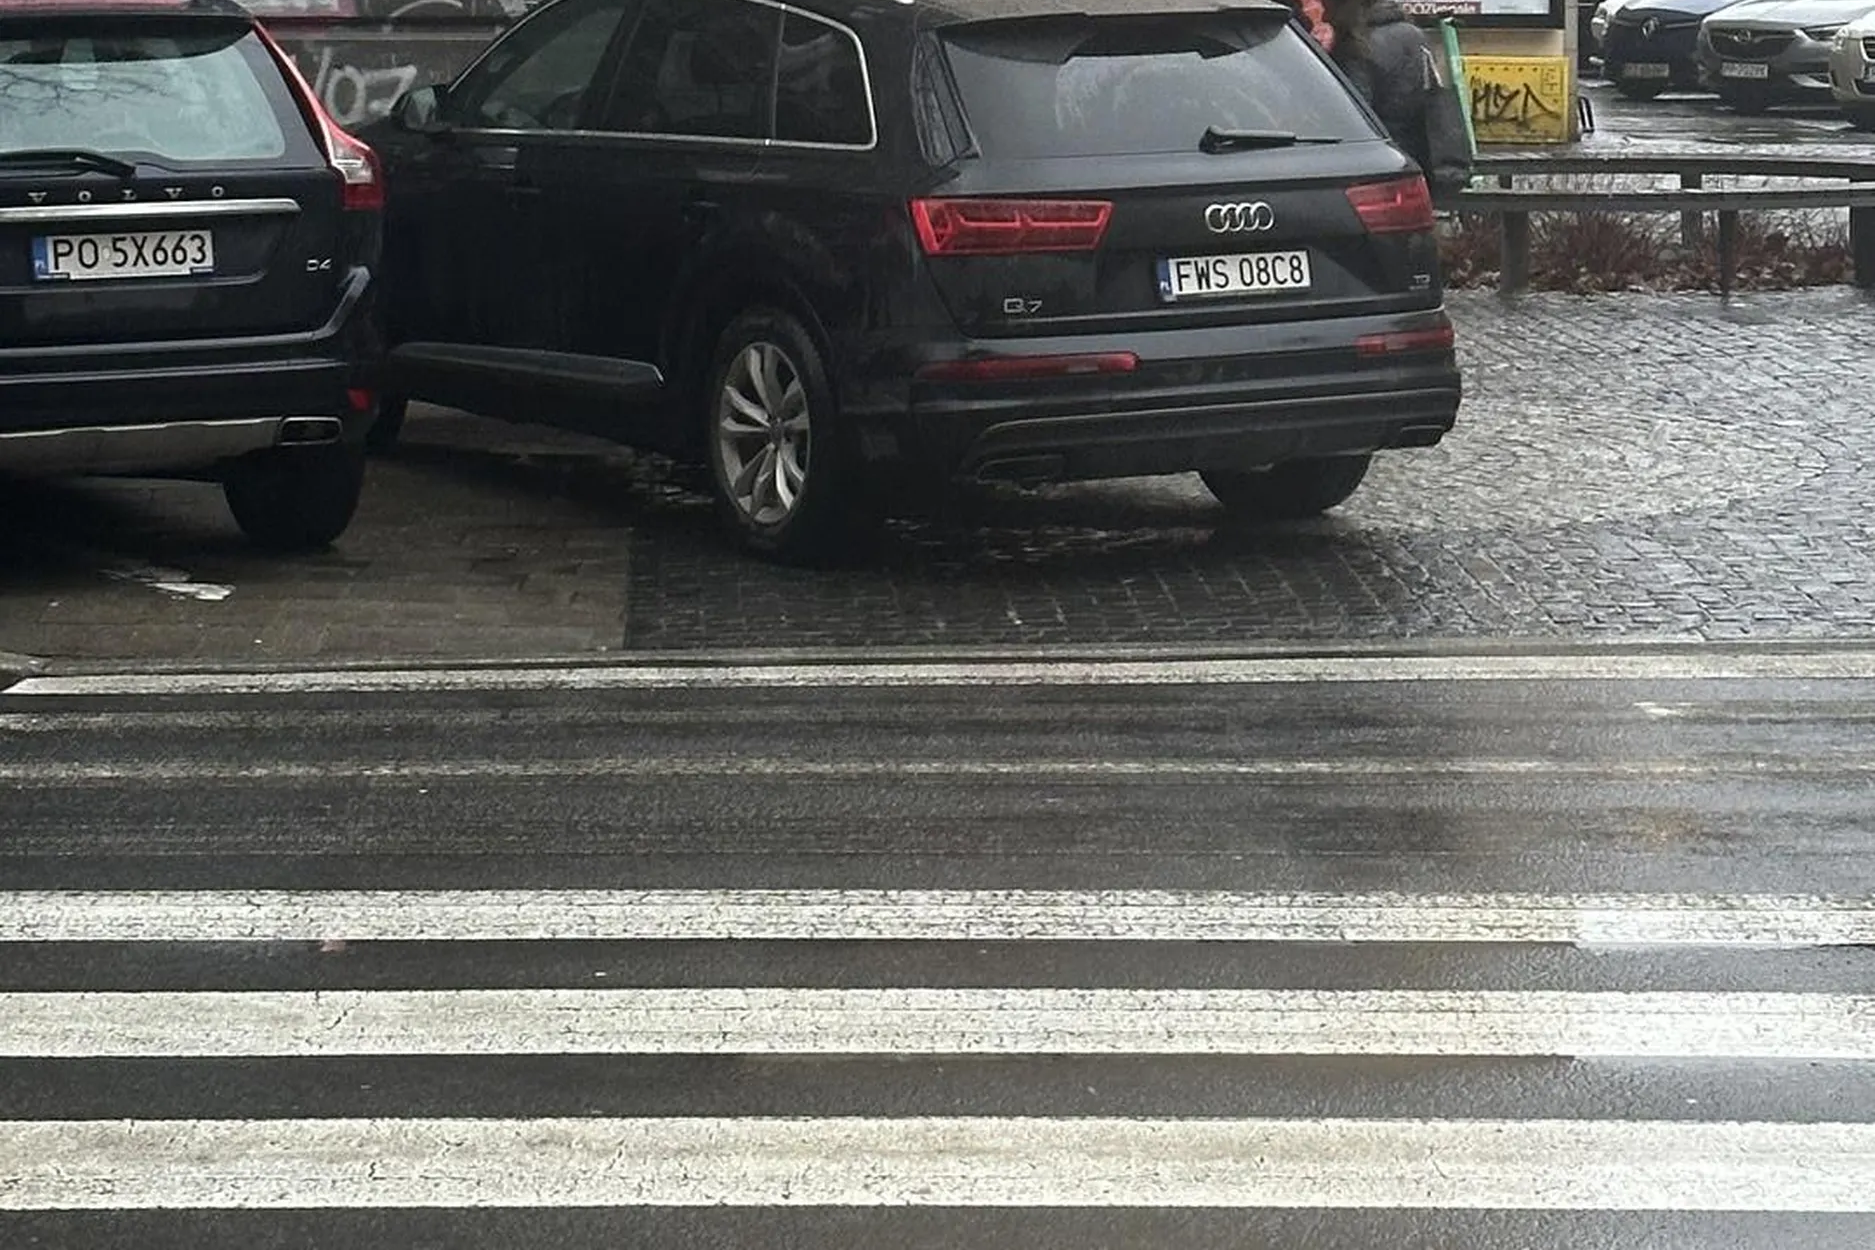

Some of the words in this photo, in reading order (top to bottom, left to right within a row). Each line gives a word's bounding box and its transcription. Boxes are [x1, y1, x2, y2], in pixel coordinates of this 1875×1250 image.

[28, 185, 225, 203] VOLVO
[52, 237, 99, 270] PO
[111, 234, 207, 266] 5X663
[305, 258, 332, 272] D4
[1176, 258, 1230, 291] FWS
[1239, 253, 1305, 288] 08C8
[1003, 297, 1043, 314] Q7
